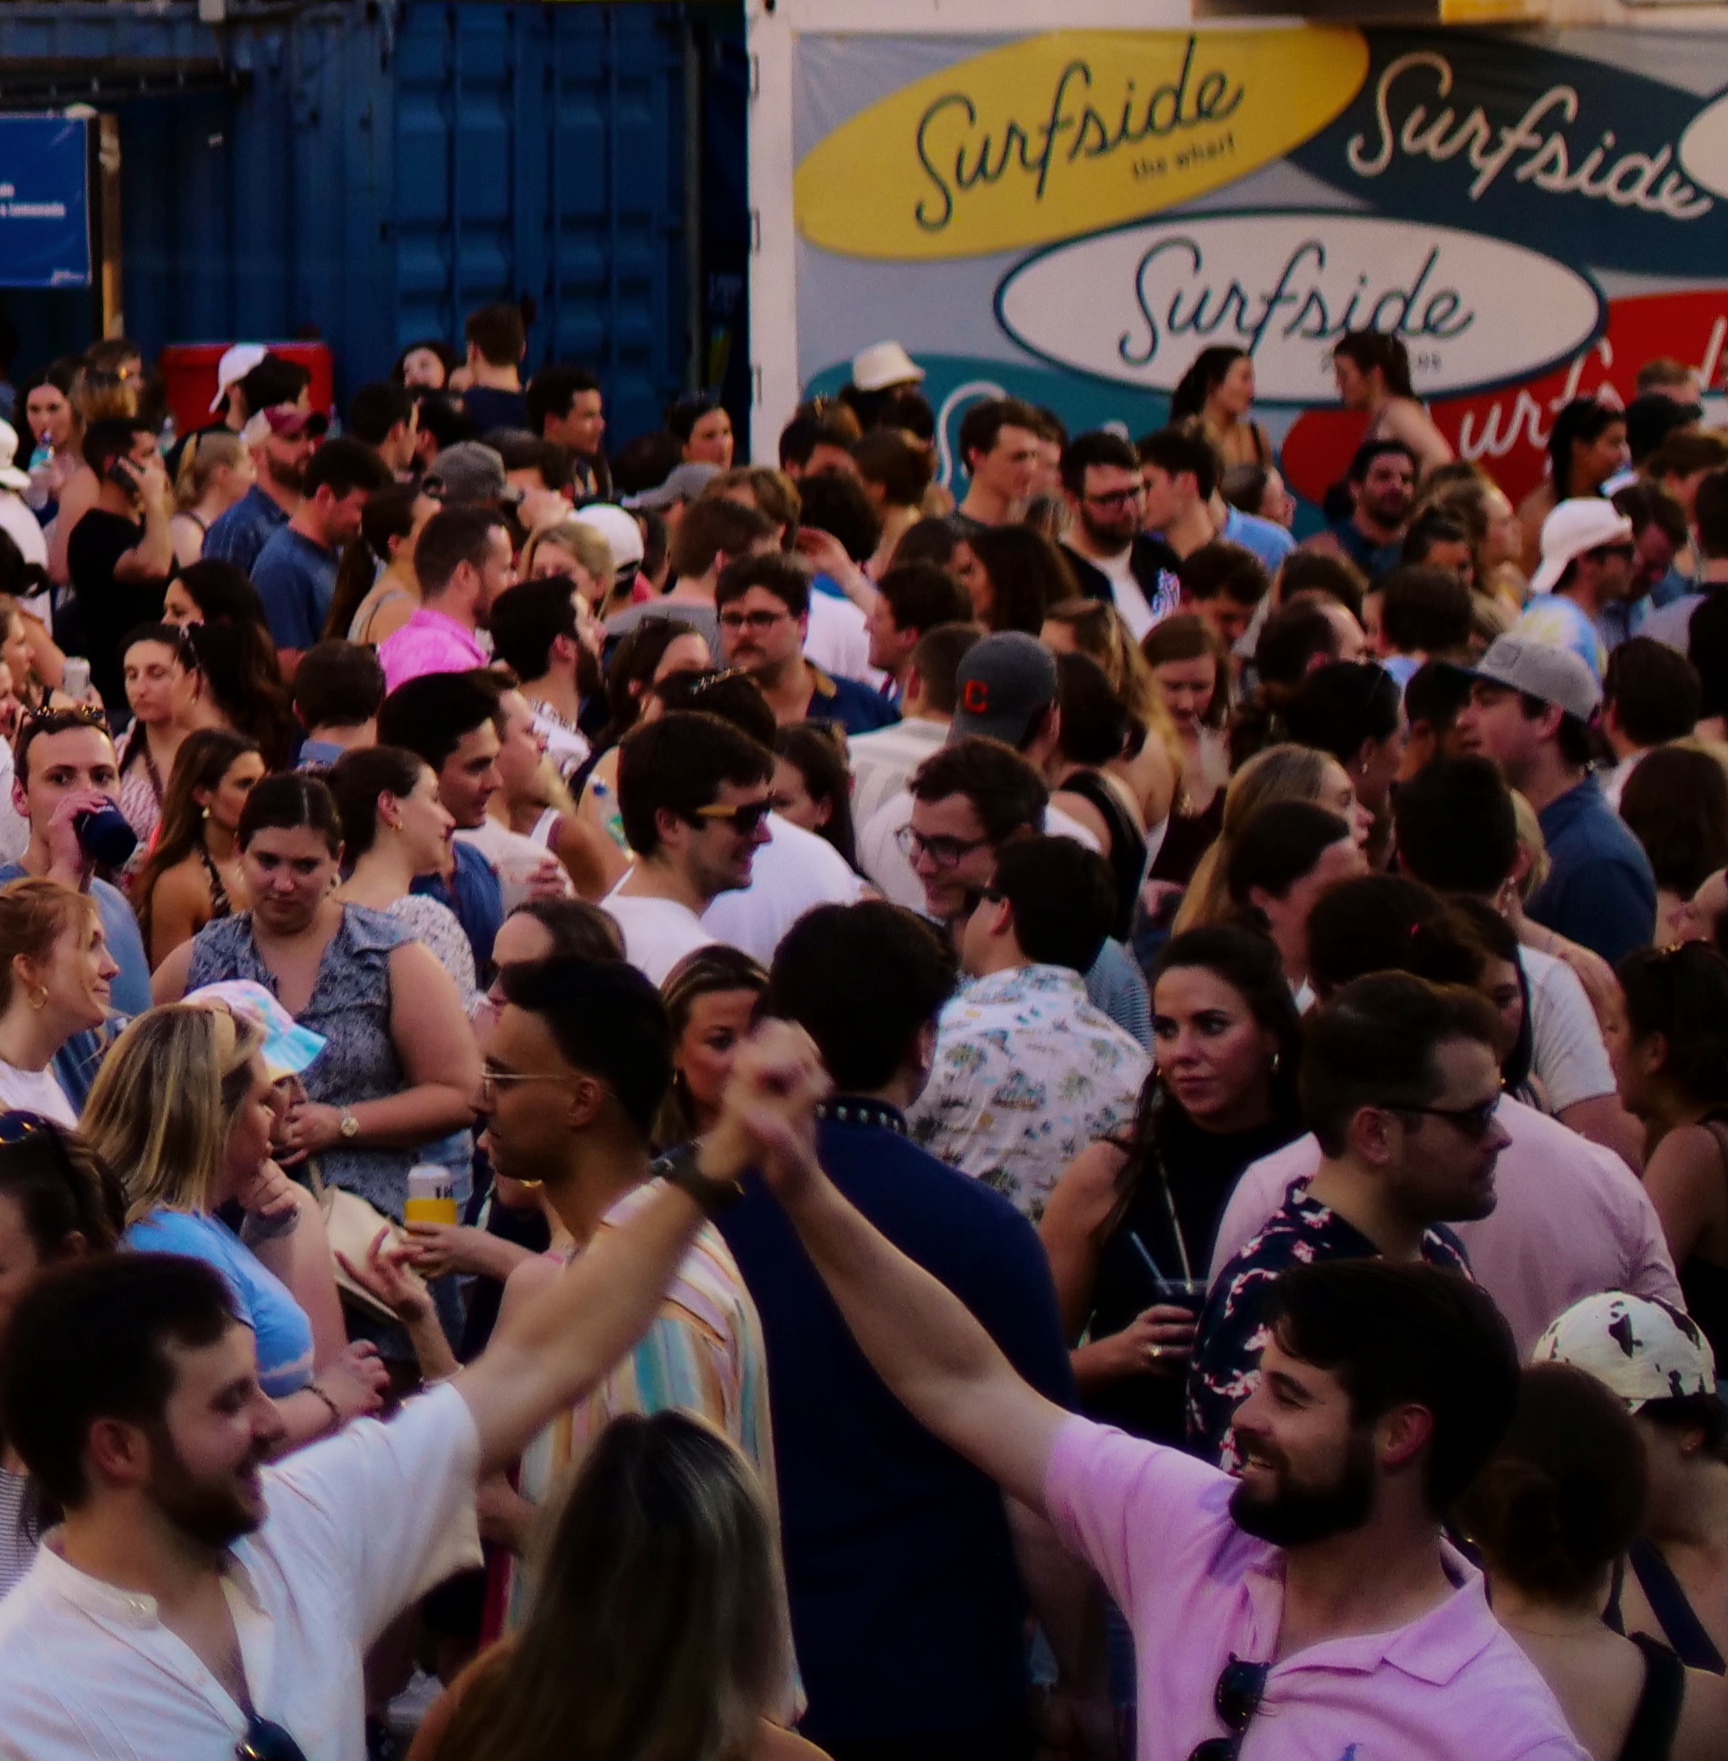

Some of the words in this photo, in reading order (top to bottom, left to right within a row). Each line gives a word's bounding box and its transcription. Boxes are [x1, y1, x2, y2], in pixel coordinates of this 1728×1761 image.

[915, 35, 1245, 232] Surfside
[1347, 51, 1714, 220] Surfside
[1119, 238, 1474, 367] Surfside
[964, 679, 989, 713] C
